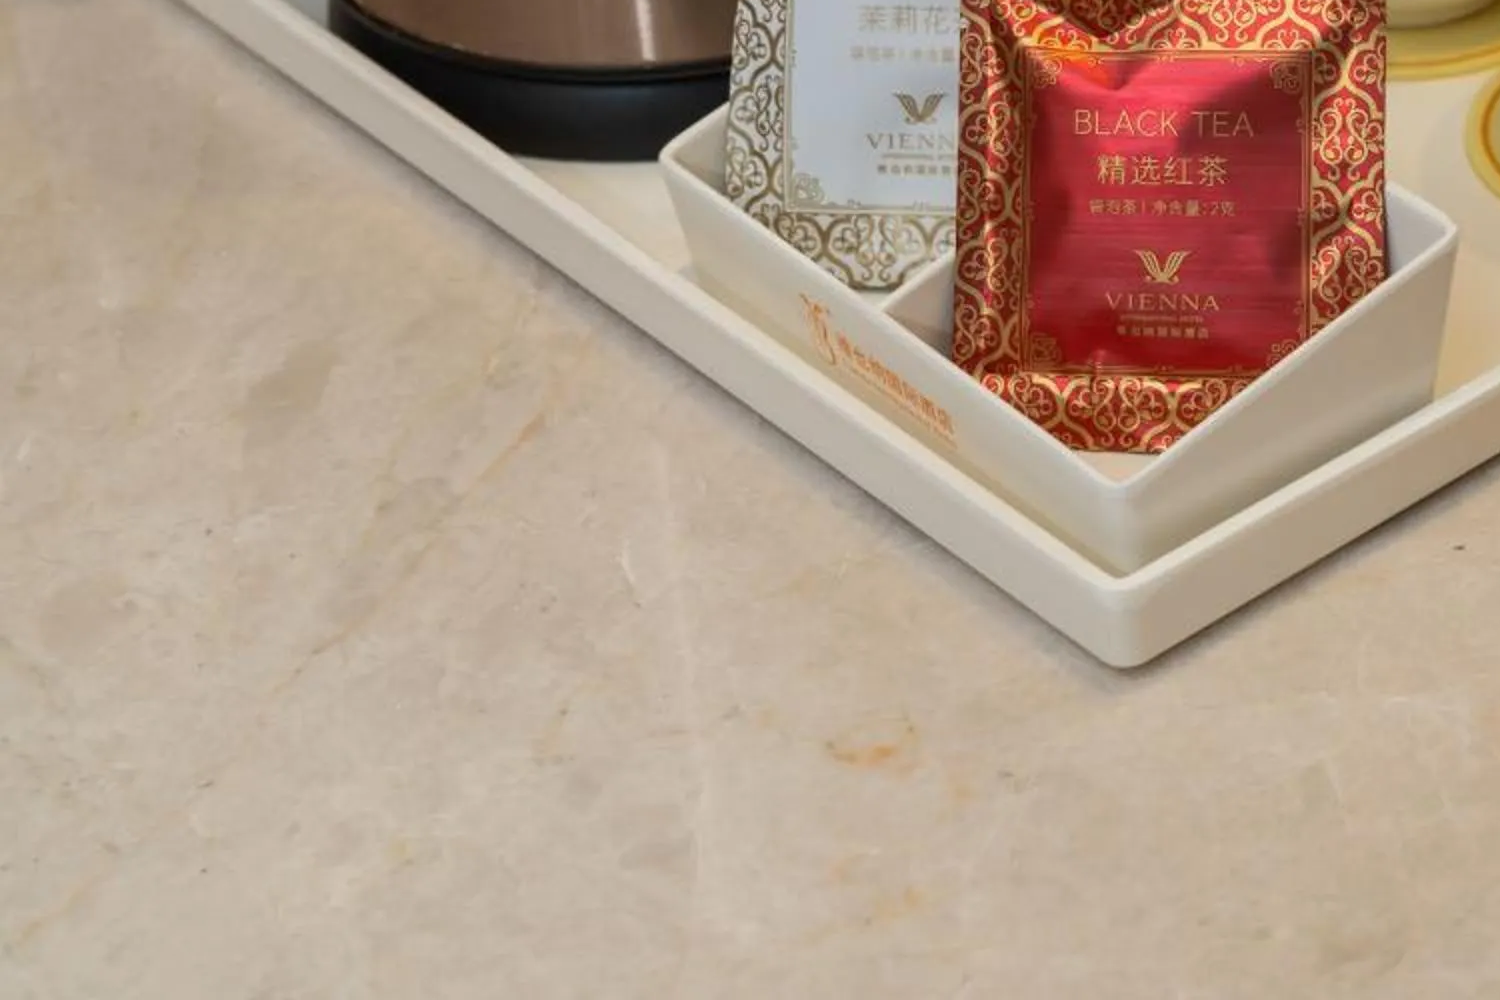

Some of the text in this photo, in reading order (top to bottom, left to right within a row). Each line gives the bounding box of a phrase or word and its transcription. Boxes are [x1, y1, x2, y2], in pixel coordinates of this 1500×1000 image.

[857, 4, 960, 35] 茉莉花
[1073, 108, 1255, 138] BLACK TEA
[865, 132, 957, 151] VIENN
[1096, 153, 1230, 188] 精选红茶
[1105, 291, 1220, 311] VIENNA
